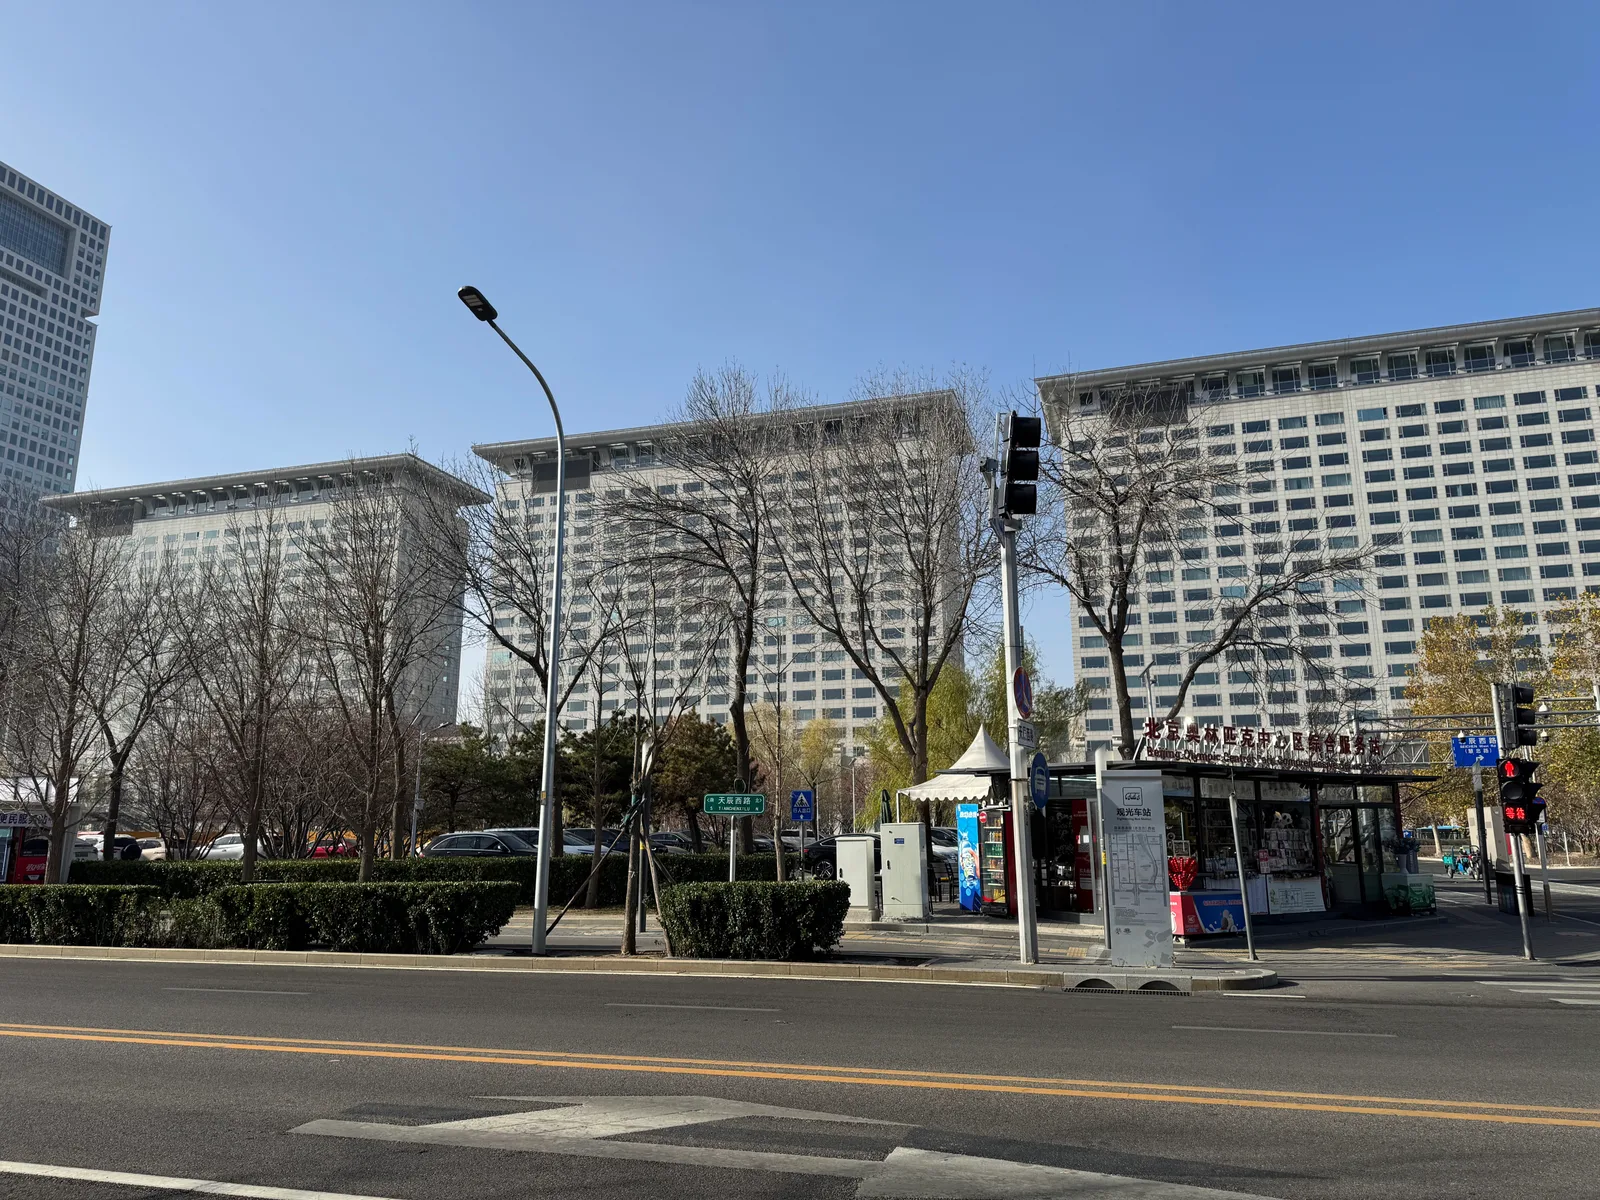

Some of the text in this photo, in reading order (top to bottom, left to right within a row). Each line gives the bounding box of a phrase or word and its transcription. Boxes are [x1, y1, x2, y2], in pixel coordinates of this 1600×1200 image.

[717, 796, 751, 805] 天辰西路
[1116, 807, 1152, 817] 观光车站
[1505, 807, 1525, 819] 等待
